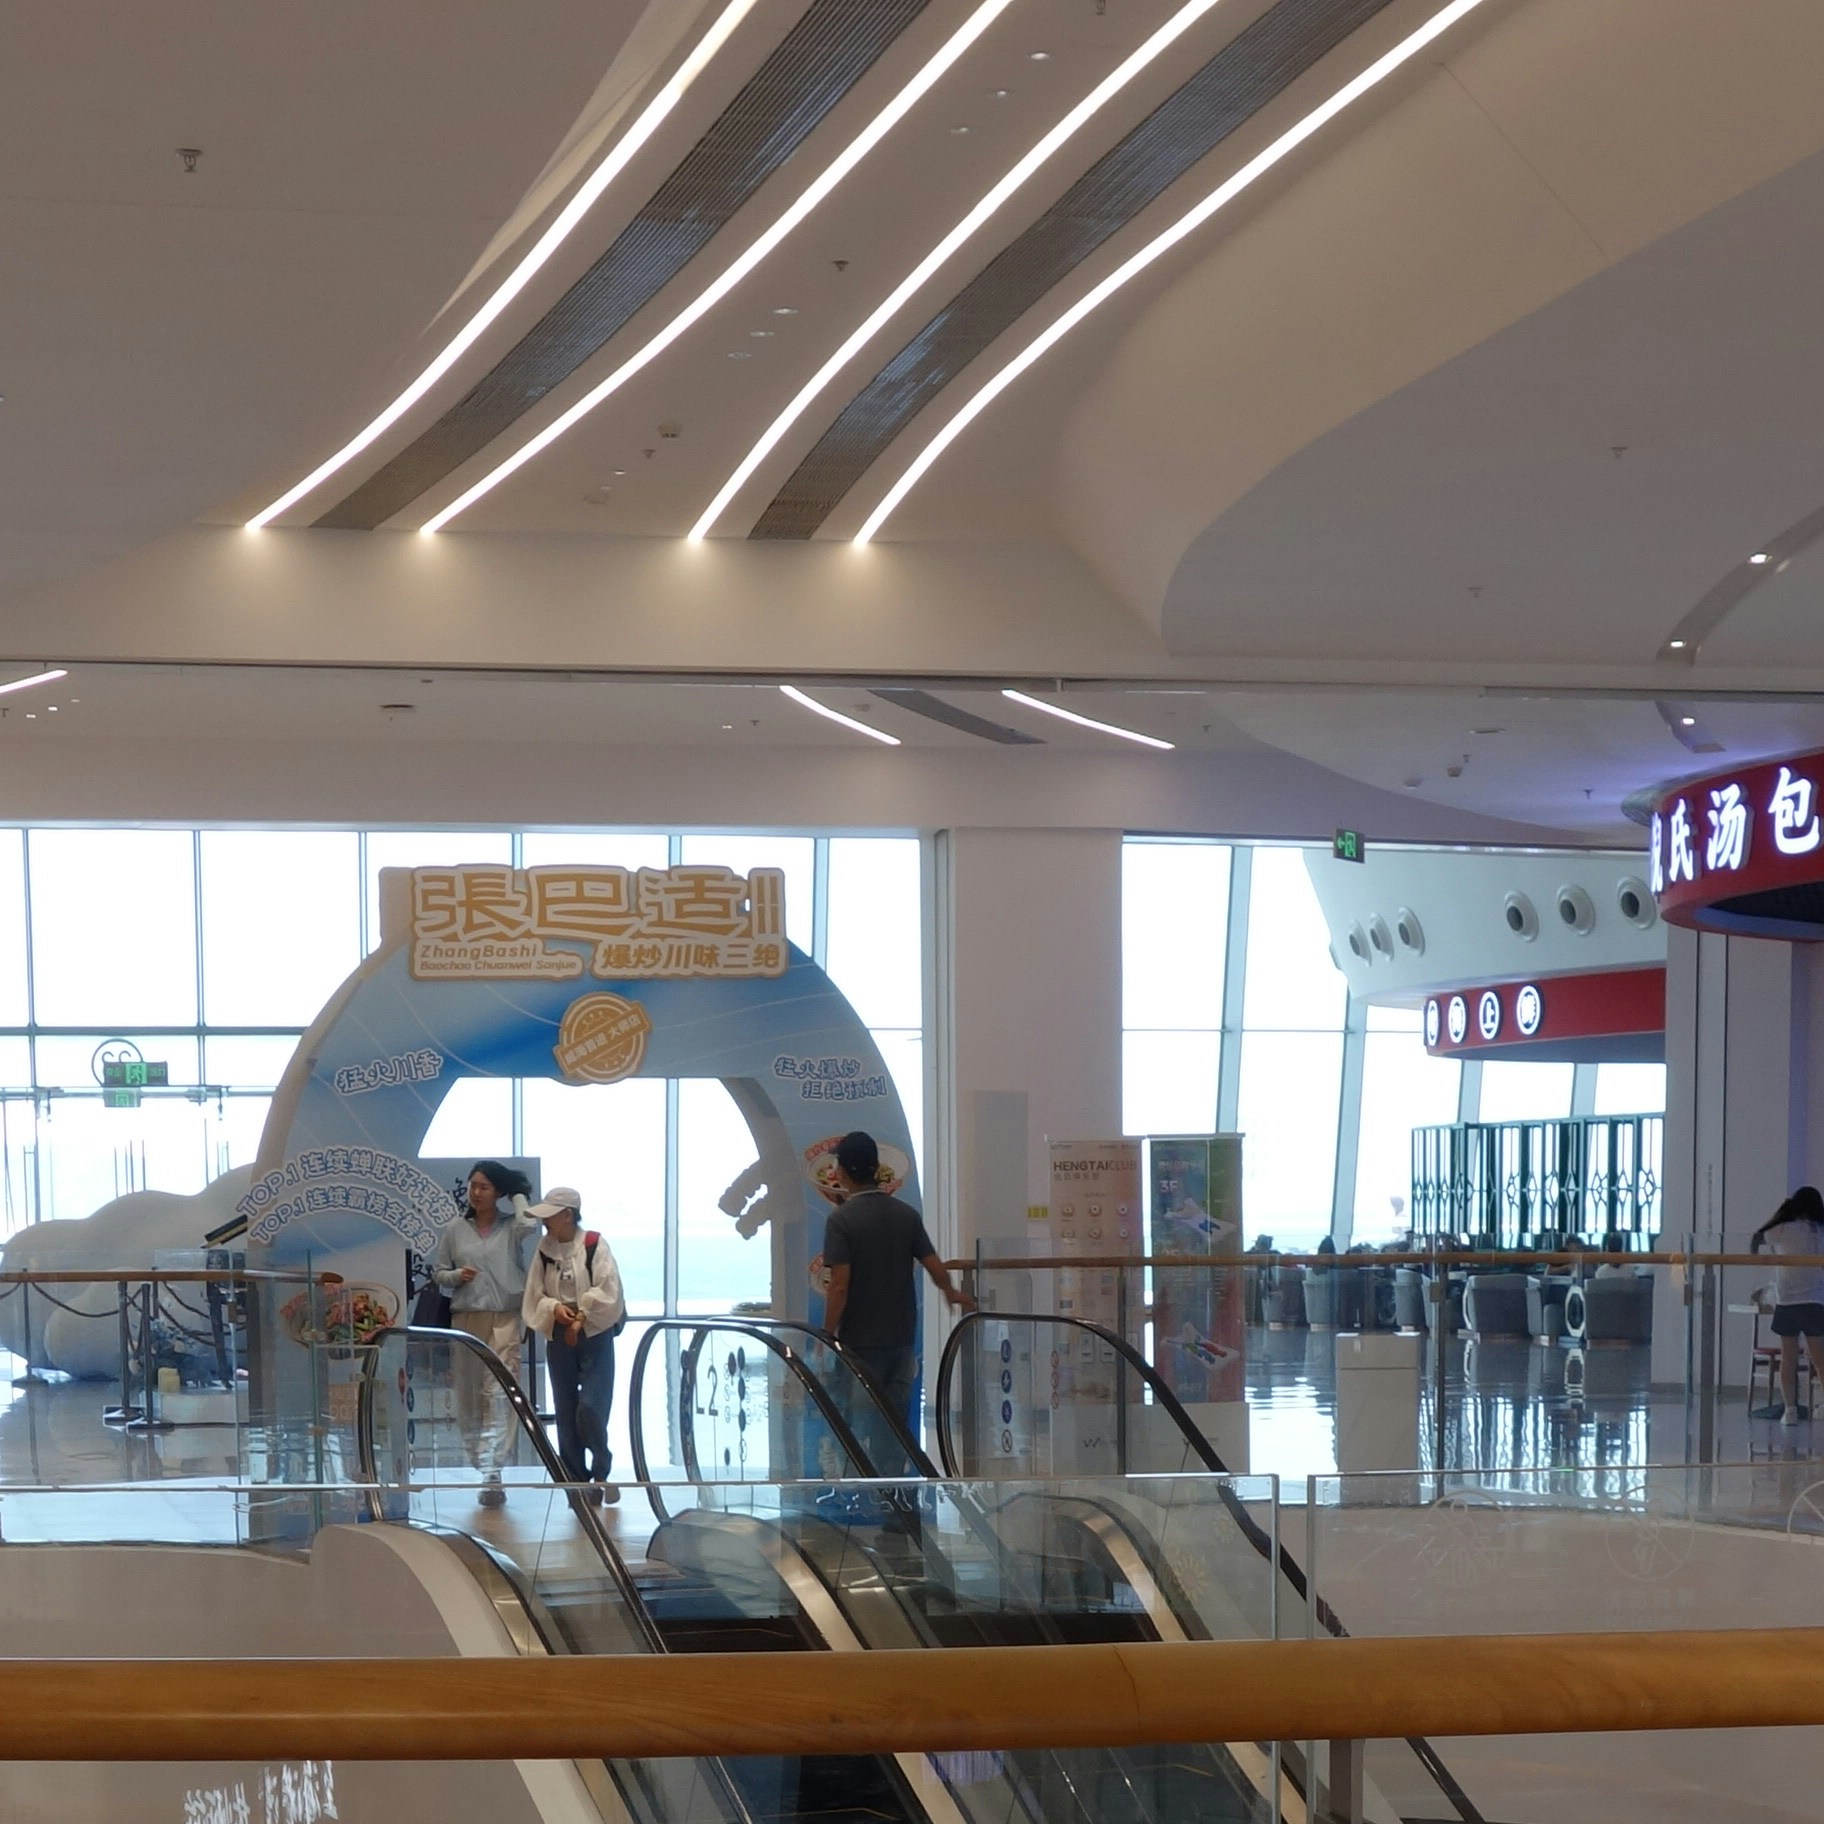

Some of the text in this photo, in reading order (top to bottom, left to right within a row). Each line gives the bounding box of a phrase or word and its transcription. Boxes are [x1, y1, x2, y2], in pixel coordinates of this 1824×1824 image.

[420, 942, 538, 960] ZhangBashi
[602, 943, 781, 970] 爆炒川味三绝
[337, 1049, 443, 1095] 猛火川香
[237, 1162, 301, 1217] TOP.1
[251, 1196, 306, 1243] TOP.1
